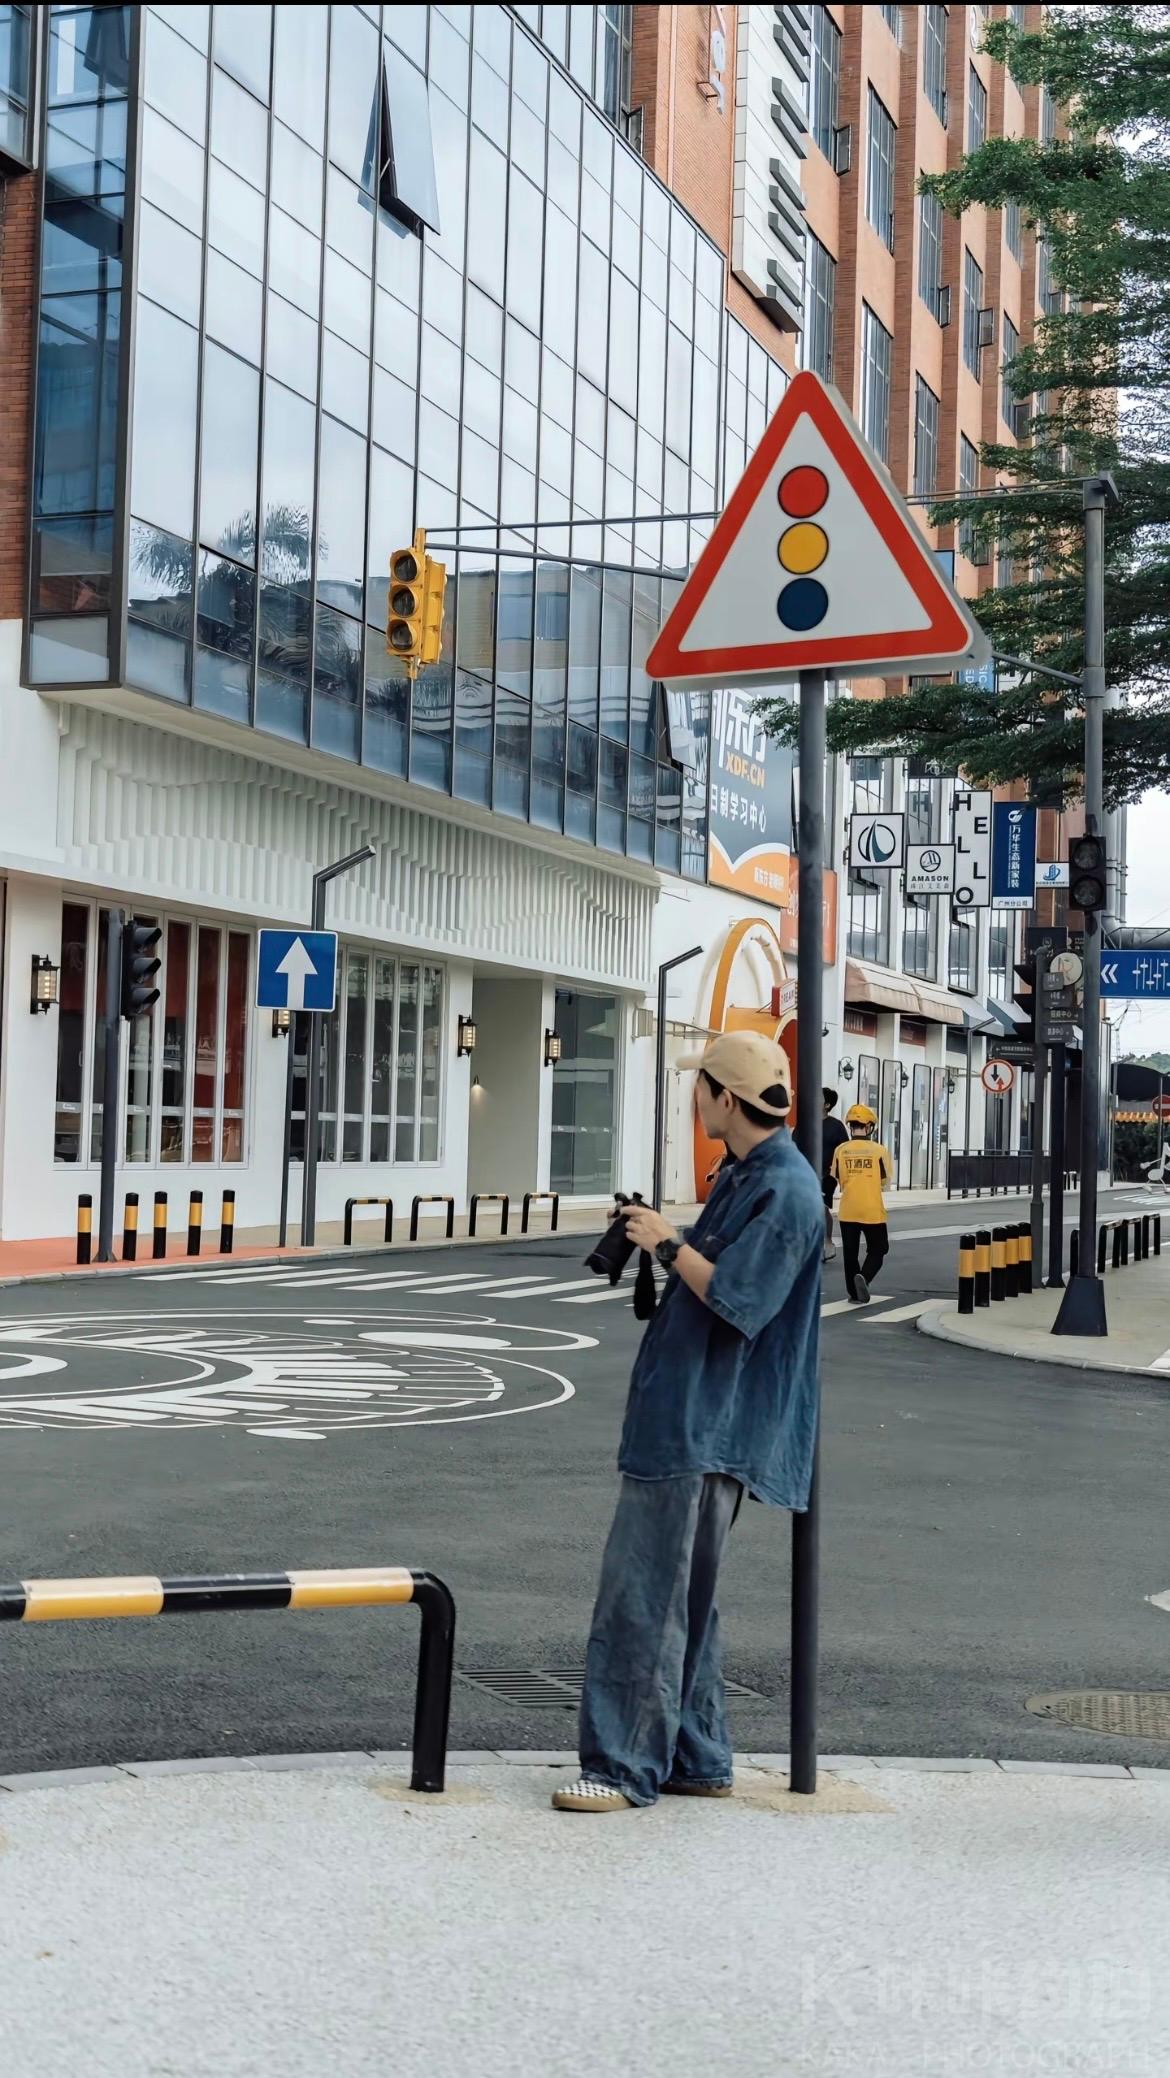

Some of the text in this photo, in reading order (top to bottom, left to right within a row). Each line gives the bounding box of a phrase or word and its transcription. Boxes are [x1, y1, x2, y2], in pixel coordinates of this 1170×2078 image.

[726, 750, 766, 789] XDF.CN
[710, 783, 767, 833] 日制学习中心
[953, 793, 989, 905] HELLO
